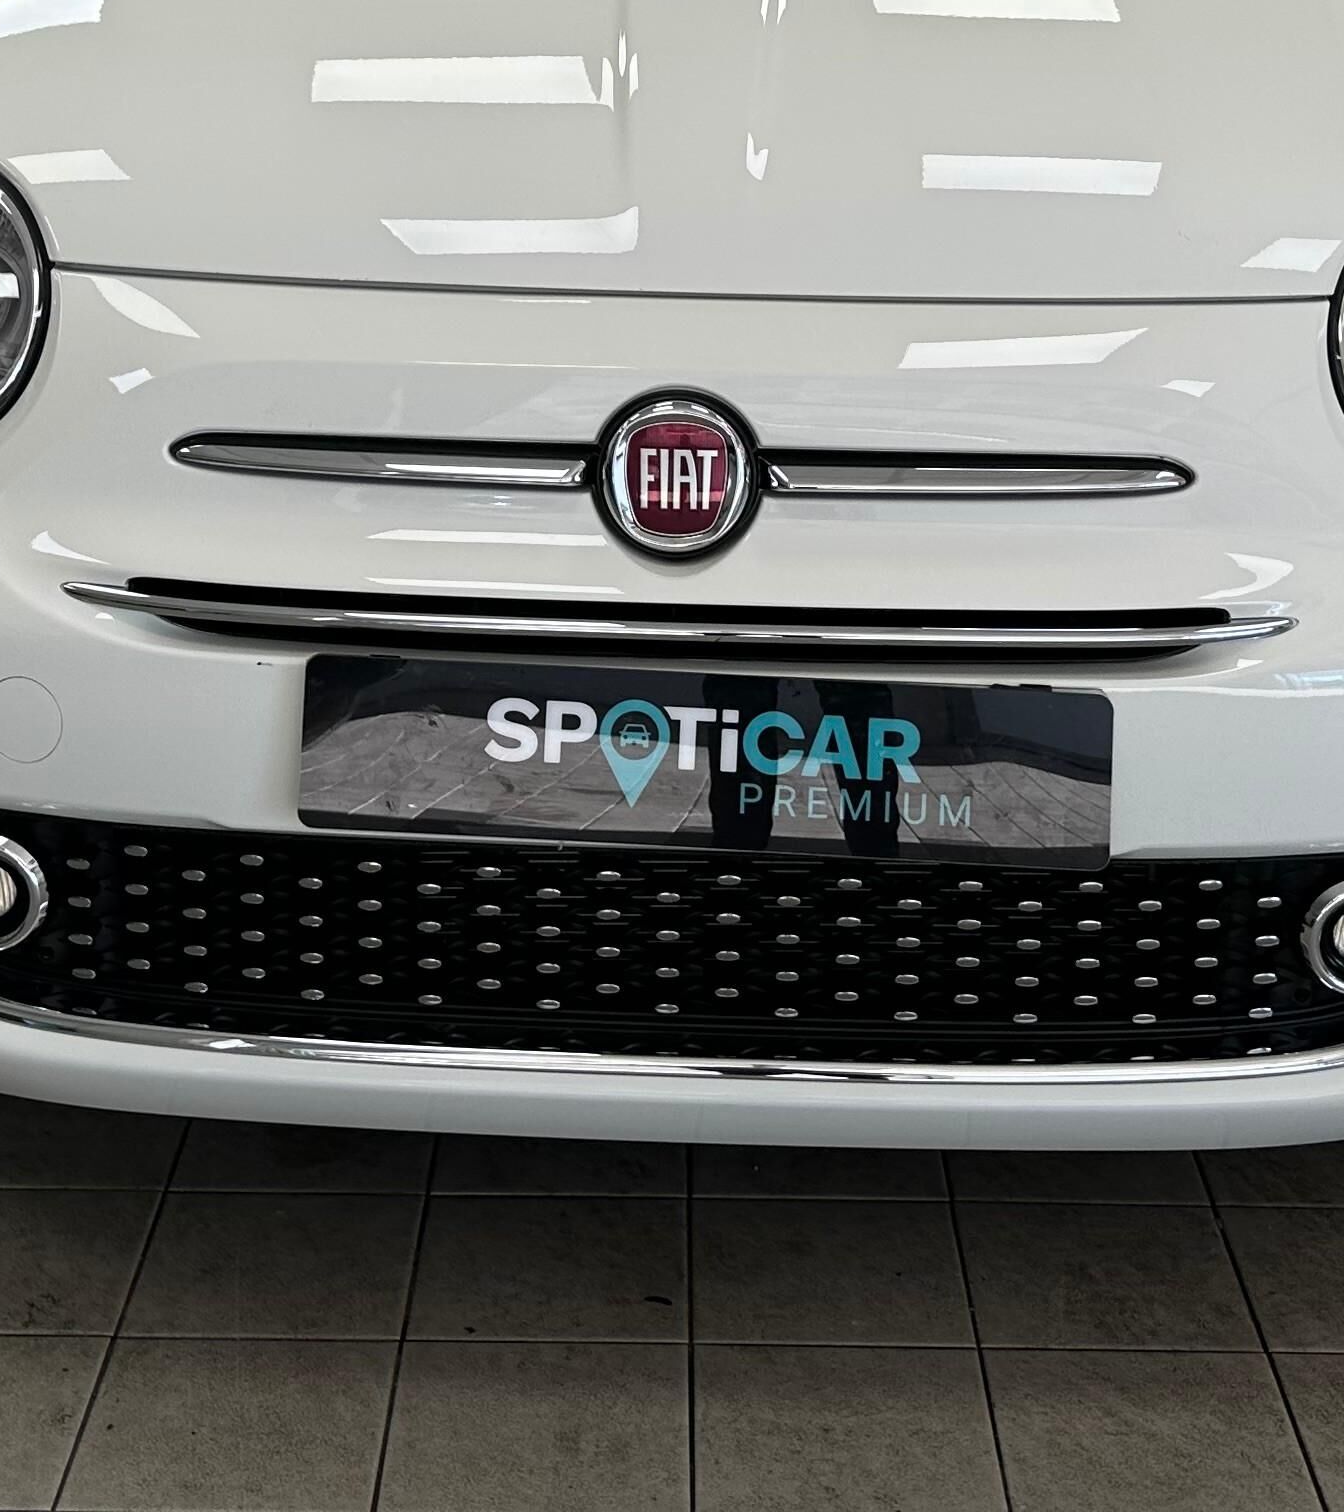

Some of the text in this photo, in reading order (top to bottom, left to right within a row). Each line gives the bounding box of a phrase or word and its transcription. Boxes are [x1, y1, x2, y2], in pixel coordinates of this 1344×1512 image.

[640, 447, 718, 510] FIAT
[484, 697, 921, 809] SPOTiCAR
[738, 783, 973, 828] PREMIUM
